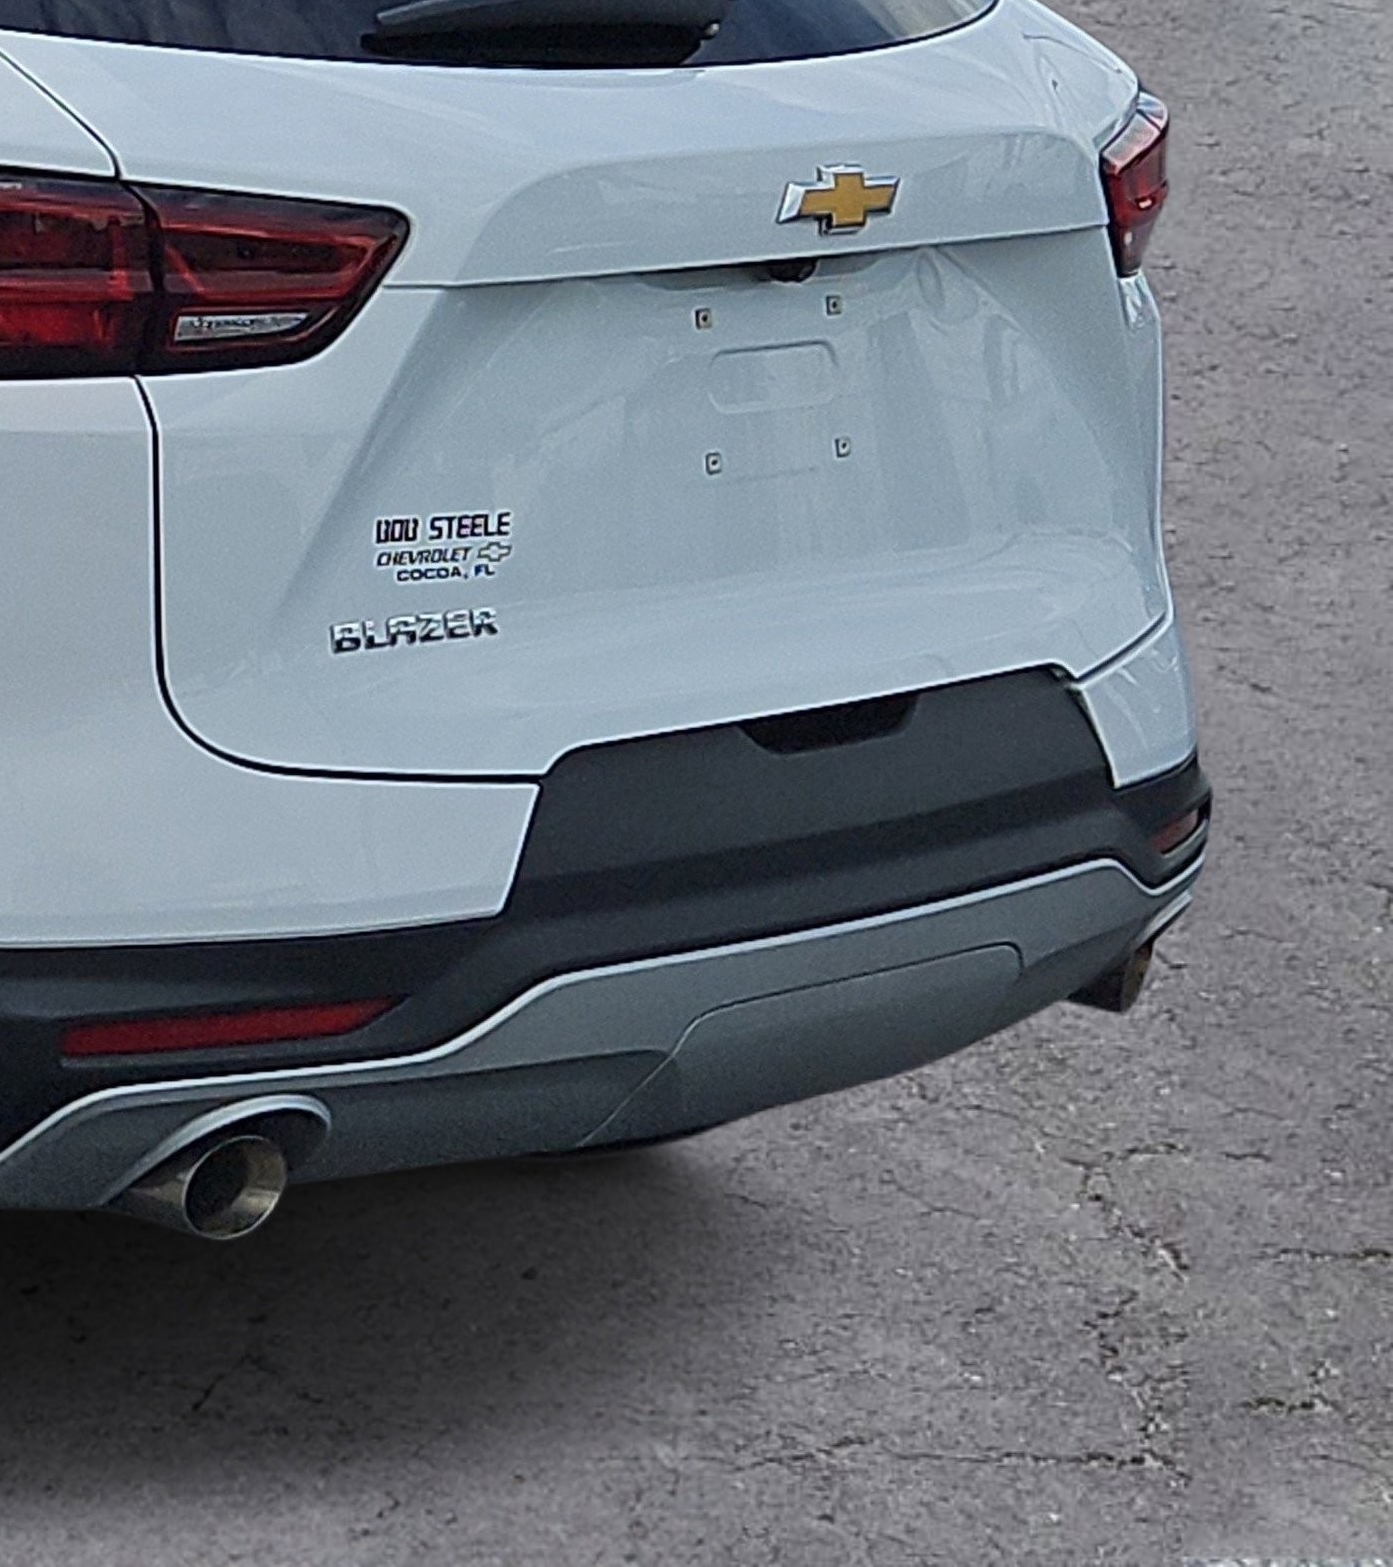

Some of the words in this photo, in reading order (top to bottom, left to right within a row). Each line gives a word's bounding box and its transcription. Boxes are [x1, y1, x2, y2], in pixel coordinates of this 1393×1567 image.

[428, 512, 511, 540] STEELE
[377, 547, 471, 566] CHEVROLET
[397, 566, 469, 582] COCOA,
[473, 563, 495, 578] FL
[330, 607, 499, 654] BLAZER
